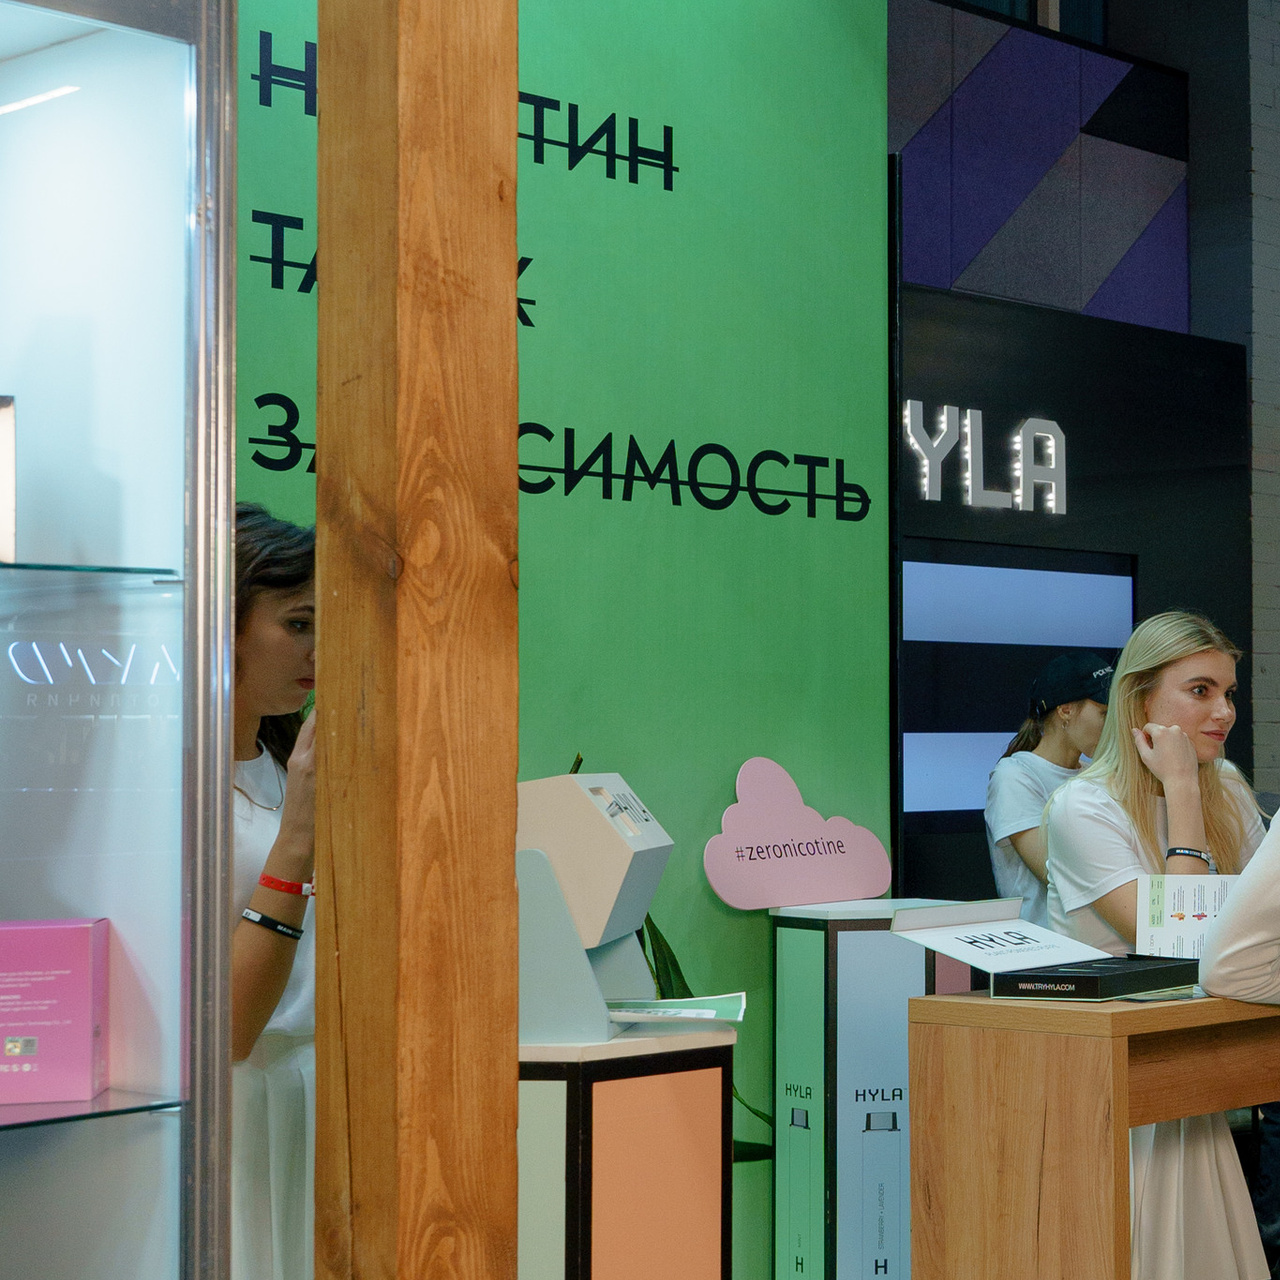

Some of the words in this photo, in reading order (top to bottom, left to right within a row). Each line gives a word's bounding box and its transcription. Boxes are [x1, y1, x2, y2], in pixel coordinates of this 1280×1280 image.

[903, 398, 1067, 516] YLA
[734, 835, 847, 863] #zeronicotine
[954, 929, 1041, 951] HYLA
[1018, 982, 1076, 992] WWW.TRYHYLA.COM
[785, 1082, 812, 1100] HYLA
[855, 1087, 903, 1102] HYLA
